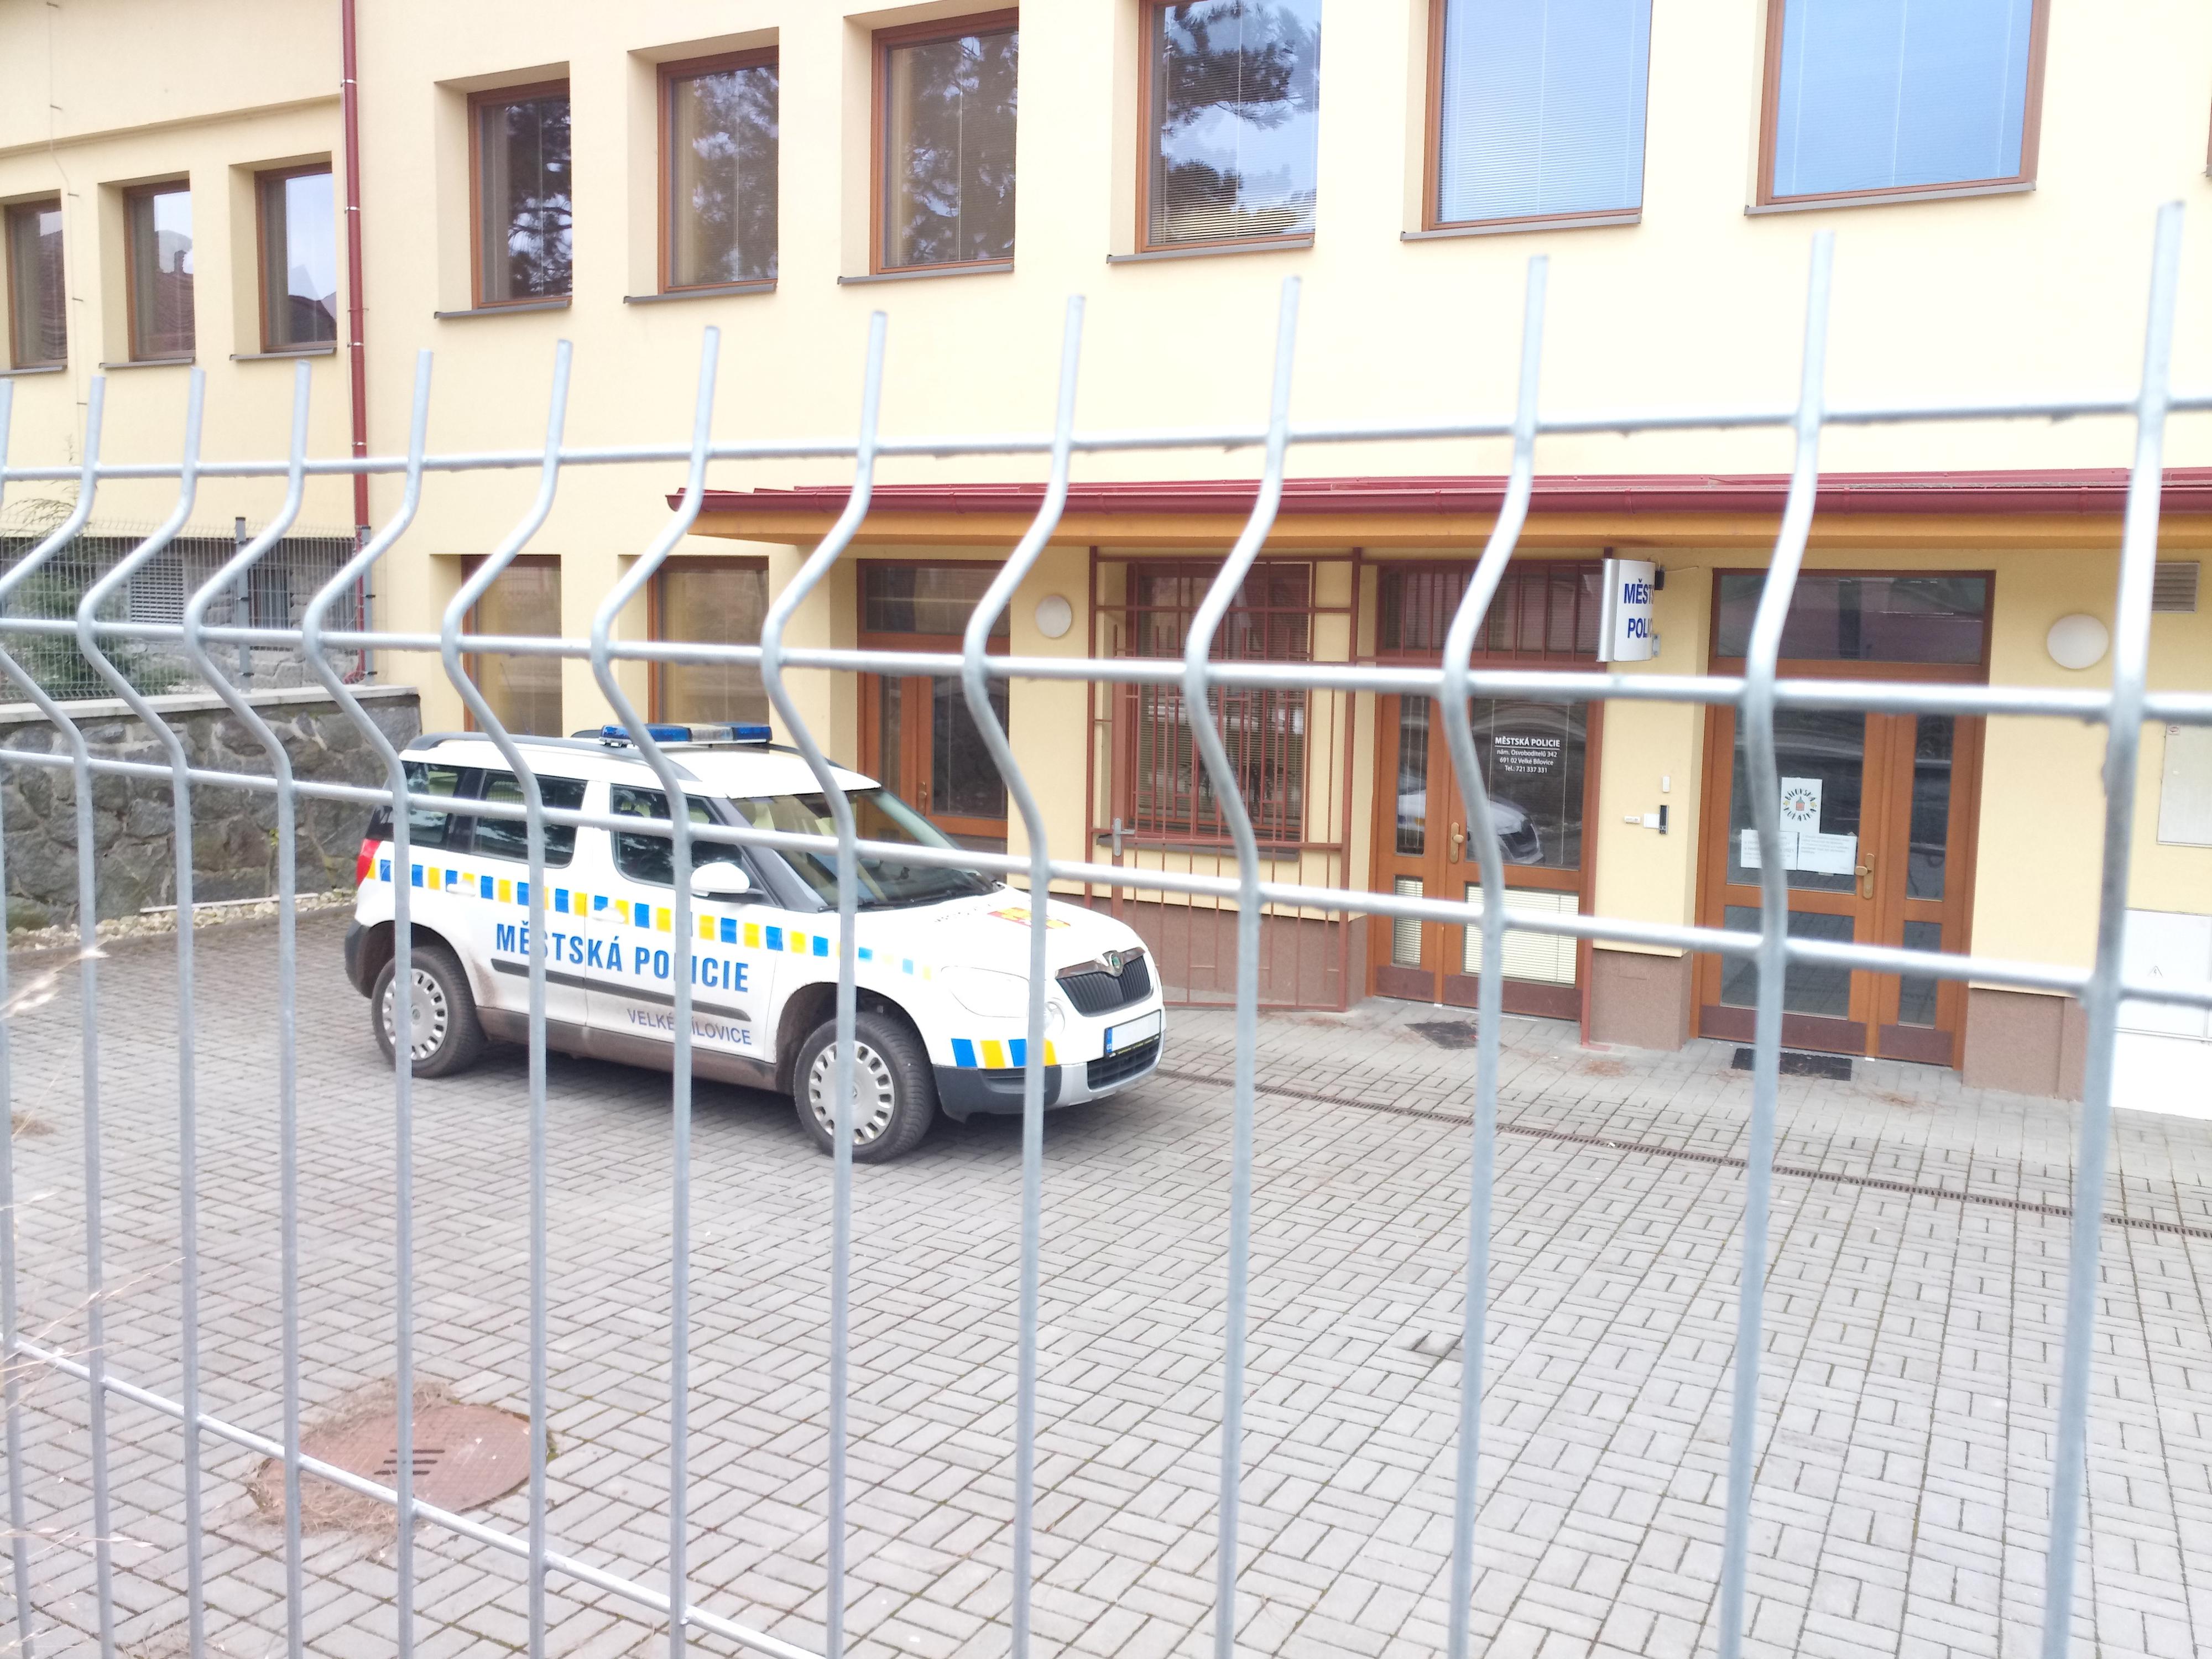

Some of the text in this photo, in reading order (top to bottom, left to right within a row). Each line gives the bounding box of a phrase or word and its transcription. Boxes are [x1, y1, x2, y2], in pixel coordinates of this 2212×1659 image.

[1495, 736, 1561, 747] MĚSTSKÁ POLICIE
[497, 920, 749, 993] MĚTSKÁ POICIE
[627, 1008, 752, 1045] VELKÉ ÍLOVICE
